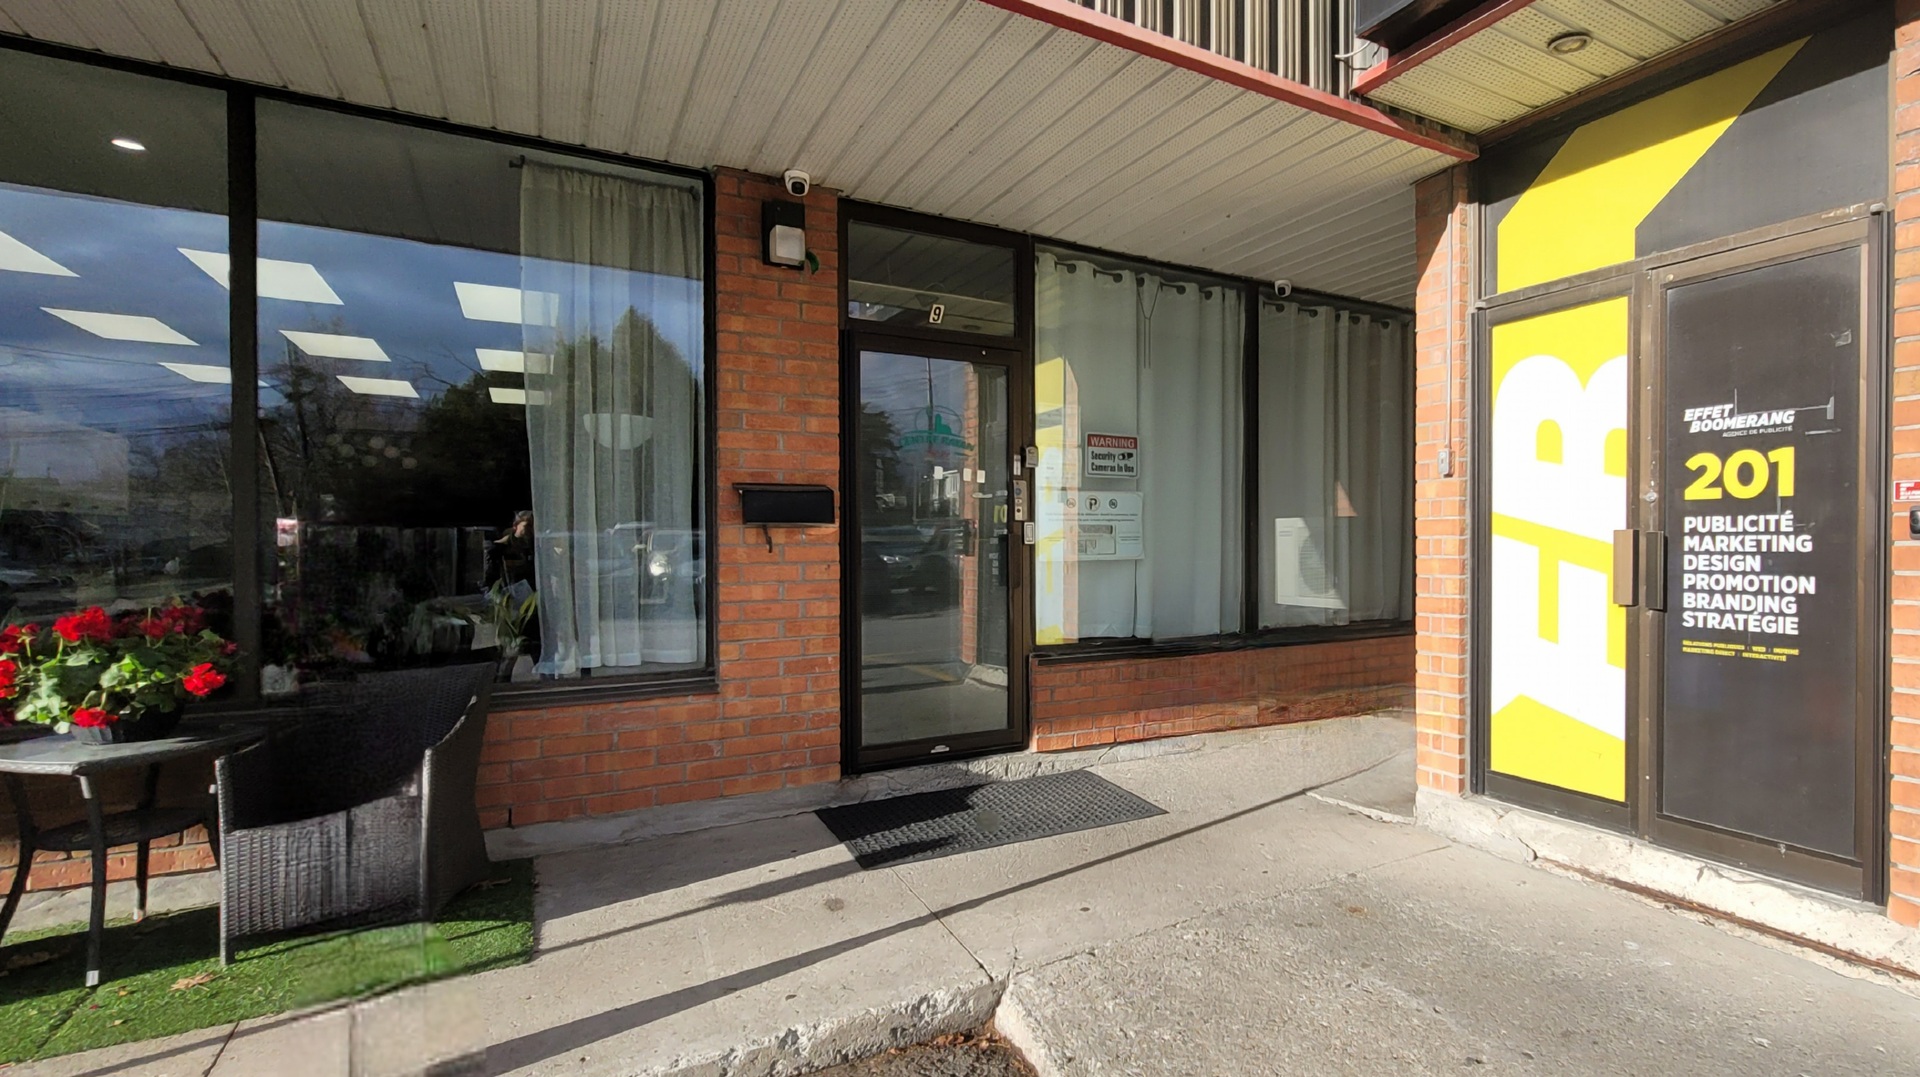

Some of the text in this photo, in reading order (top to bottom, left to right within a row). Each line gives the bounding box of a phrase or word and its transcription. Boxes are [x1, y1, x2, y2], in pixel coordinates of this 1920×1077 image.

[932, 306, 942, 322] 9
[1683, 403, 1734, 422] EFFET
[1689, 410, 1796, 433] BOOMERANG
[1090, 436, 1135, 448] WARNING
[1091, 450, 1116, 463] Security
[1091, 462, 1134, 473] Cameras In Use
[1684, 446, 1795, 501] 201
[1683, 510, 1794, 533] PUBLICITÉ
[1683, 535, 1813, 552] MARKETING
[1683, 554, 1761, 572] DESIGN
[1683, 573, 1816, 595] PROMOTION
[1682, 592, 1797, 614] BRANDING
[1682, 610, 1799, 635] STRATÉGIE
